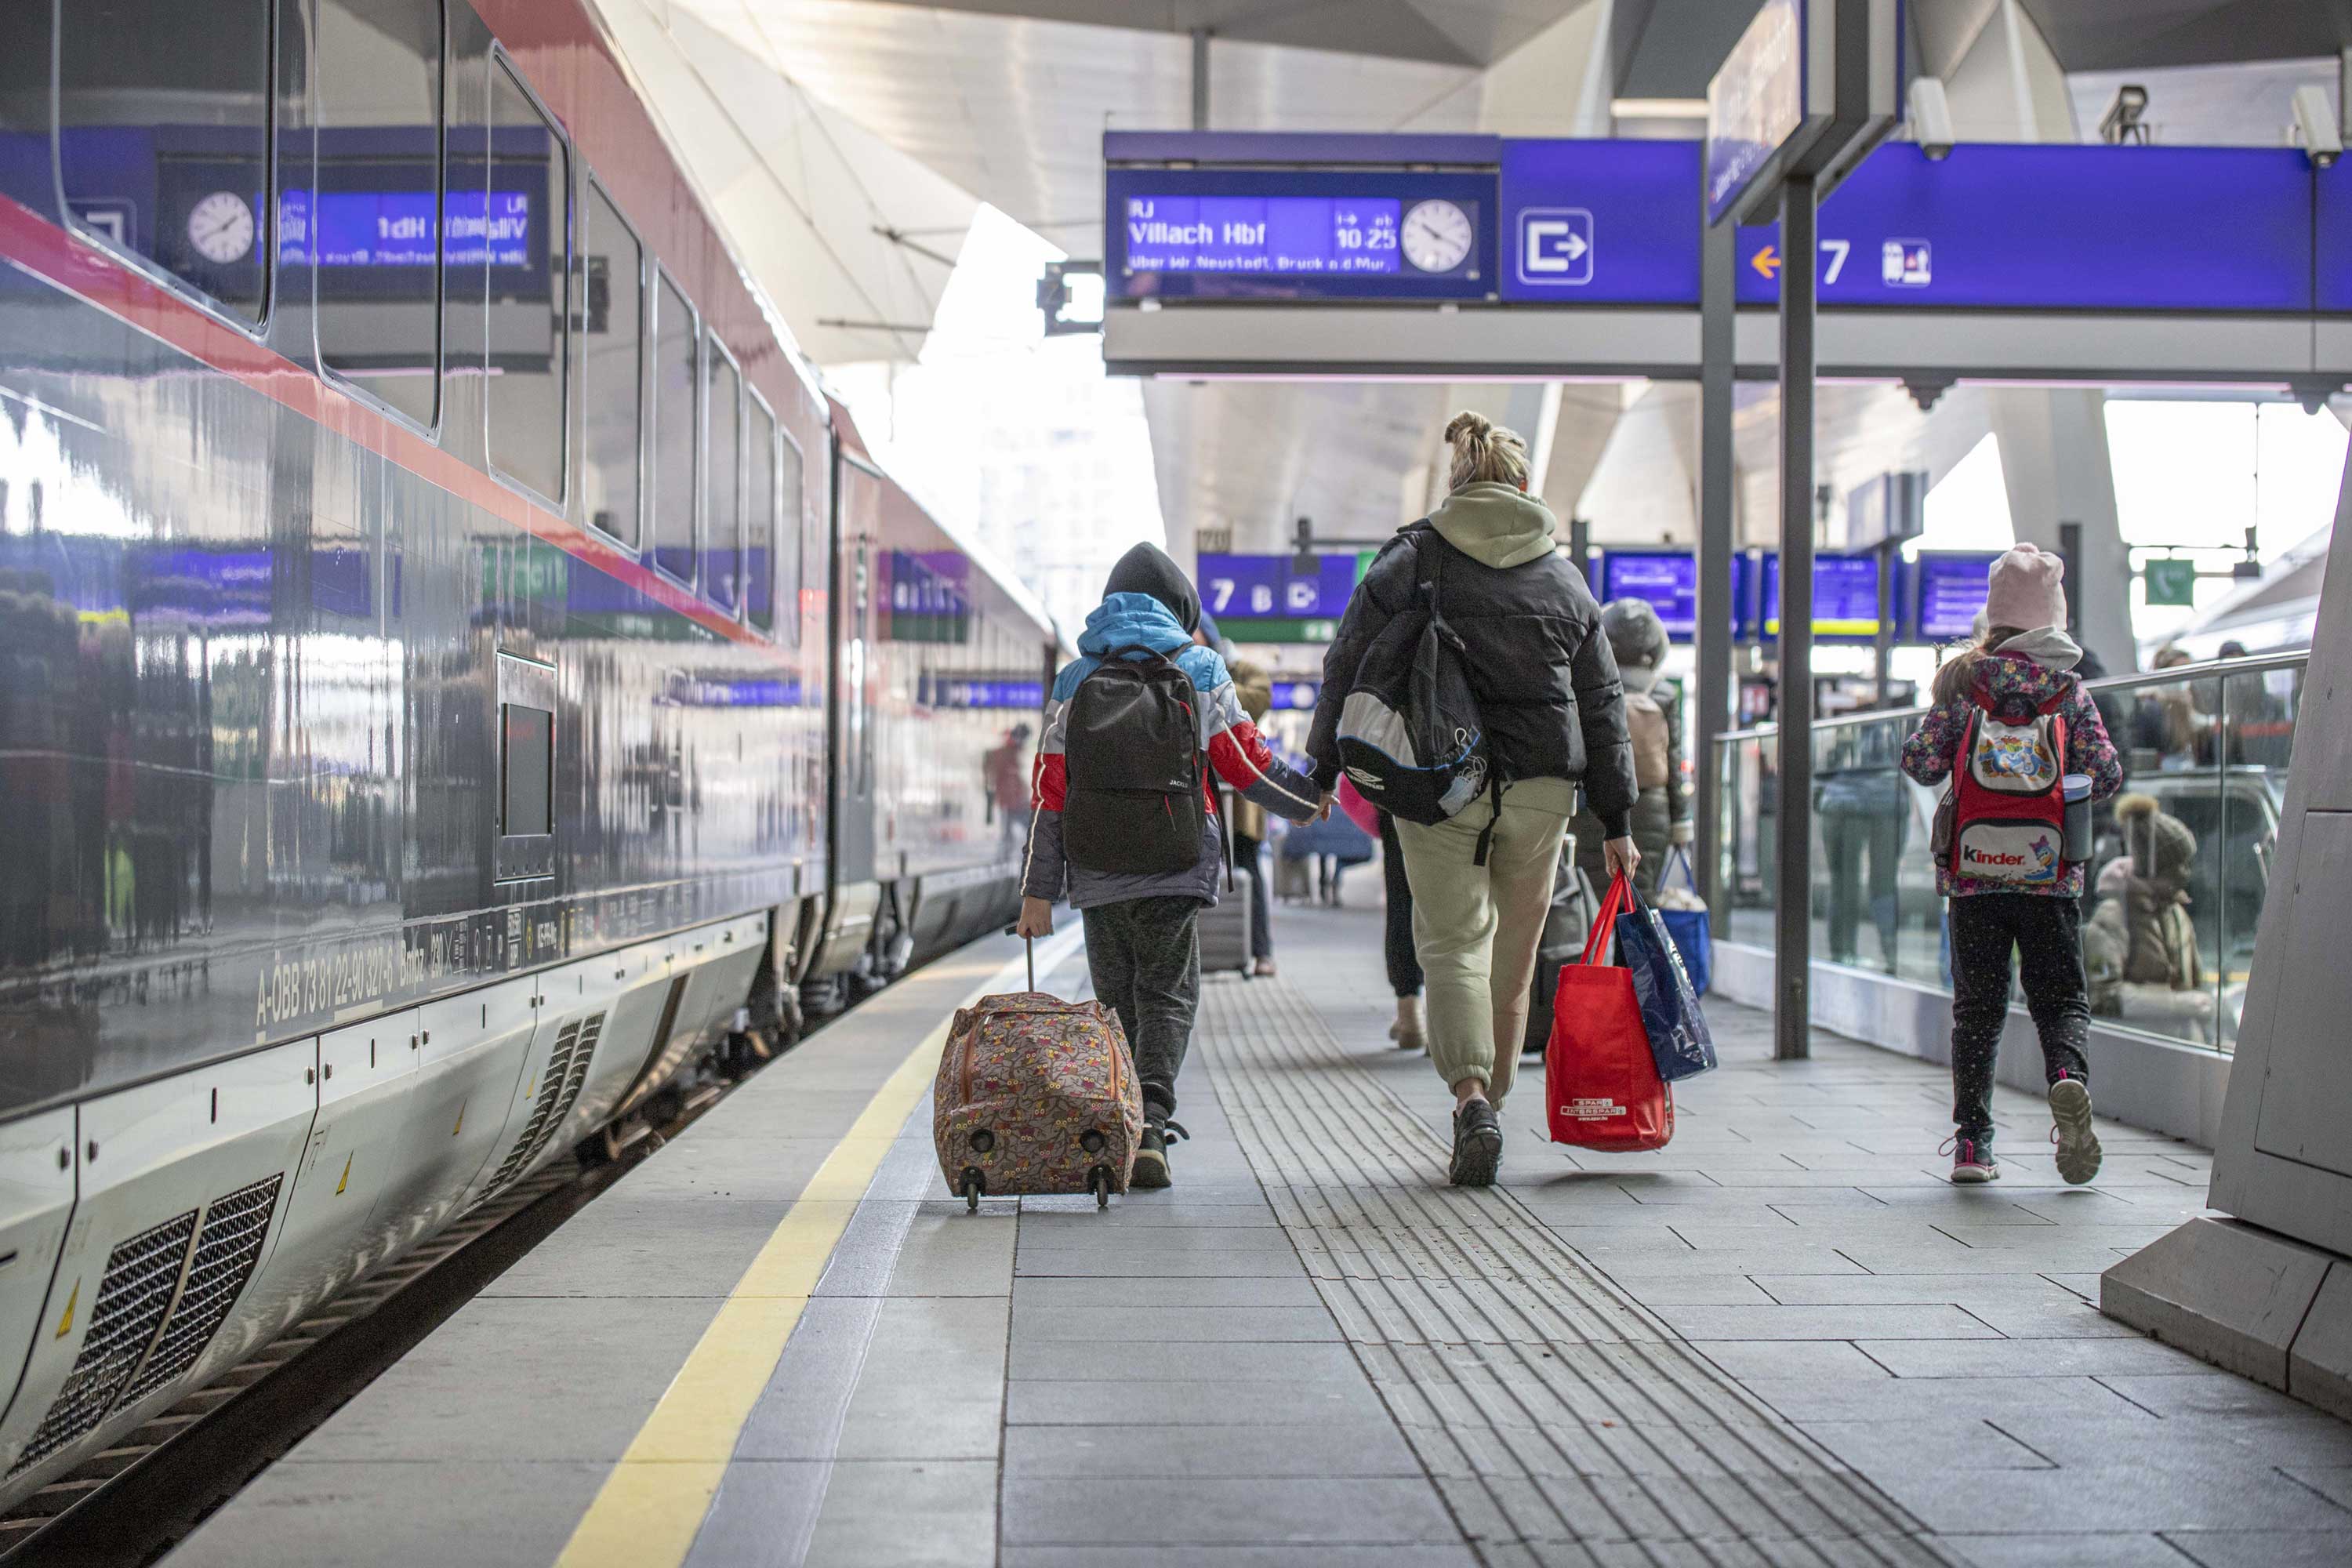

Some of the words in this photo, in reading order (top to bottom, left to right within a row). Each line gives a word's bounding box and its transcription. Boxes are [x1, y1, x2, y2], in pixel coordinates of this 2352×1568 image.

[1128, 199, 1154, 218] RJ
[1129, 222, 1214, 245] Villach
[1223, 222, 1266, 245] Hbf
[1819, 239, 1850, 285] 7
[1210, 578, 1236, 613] 7
[256, 949, 300, 1027] A-ÖBB
[303, 959, 317, 1014] 73
[319, 956, 332, 1011] 81
[335, 950, 364, 1006] 22-90
[365, 945, 393, 999] 327-6
[400, 939, 425, 995] Bmpz
